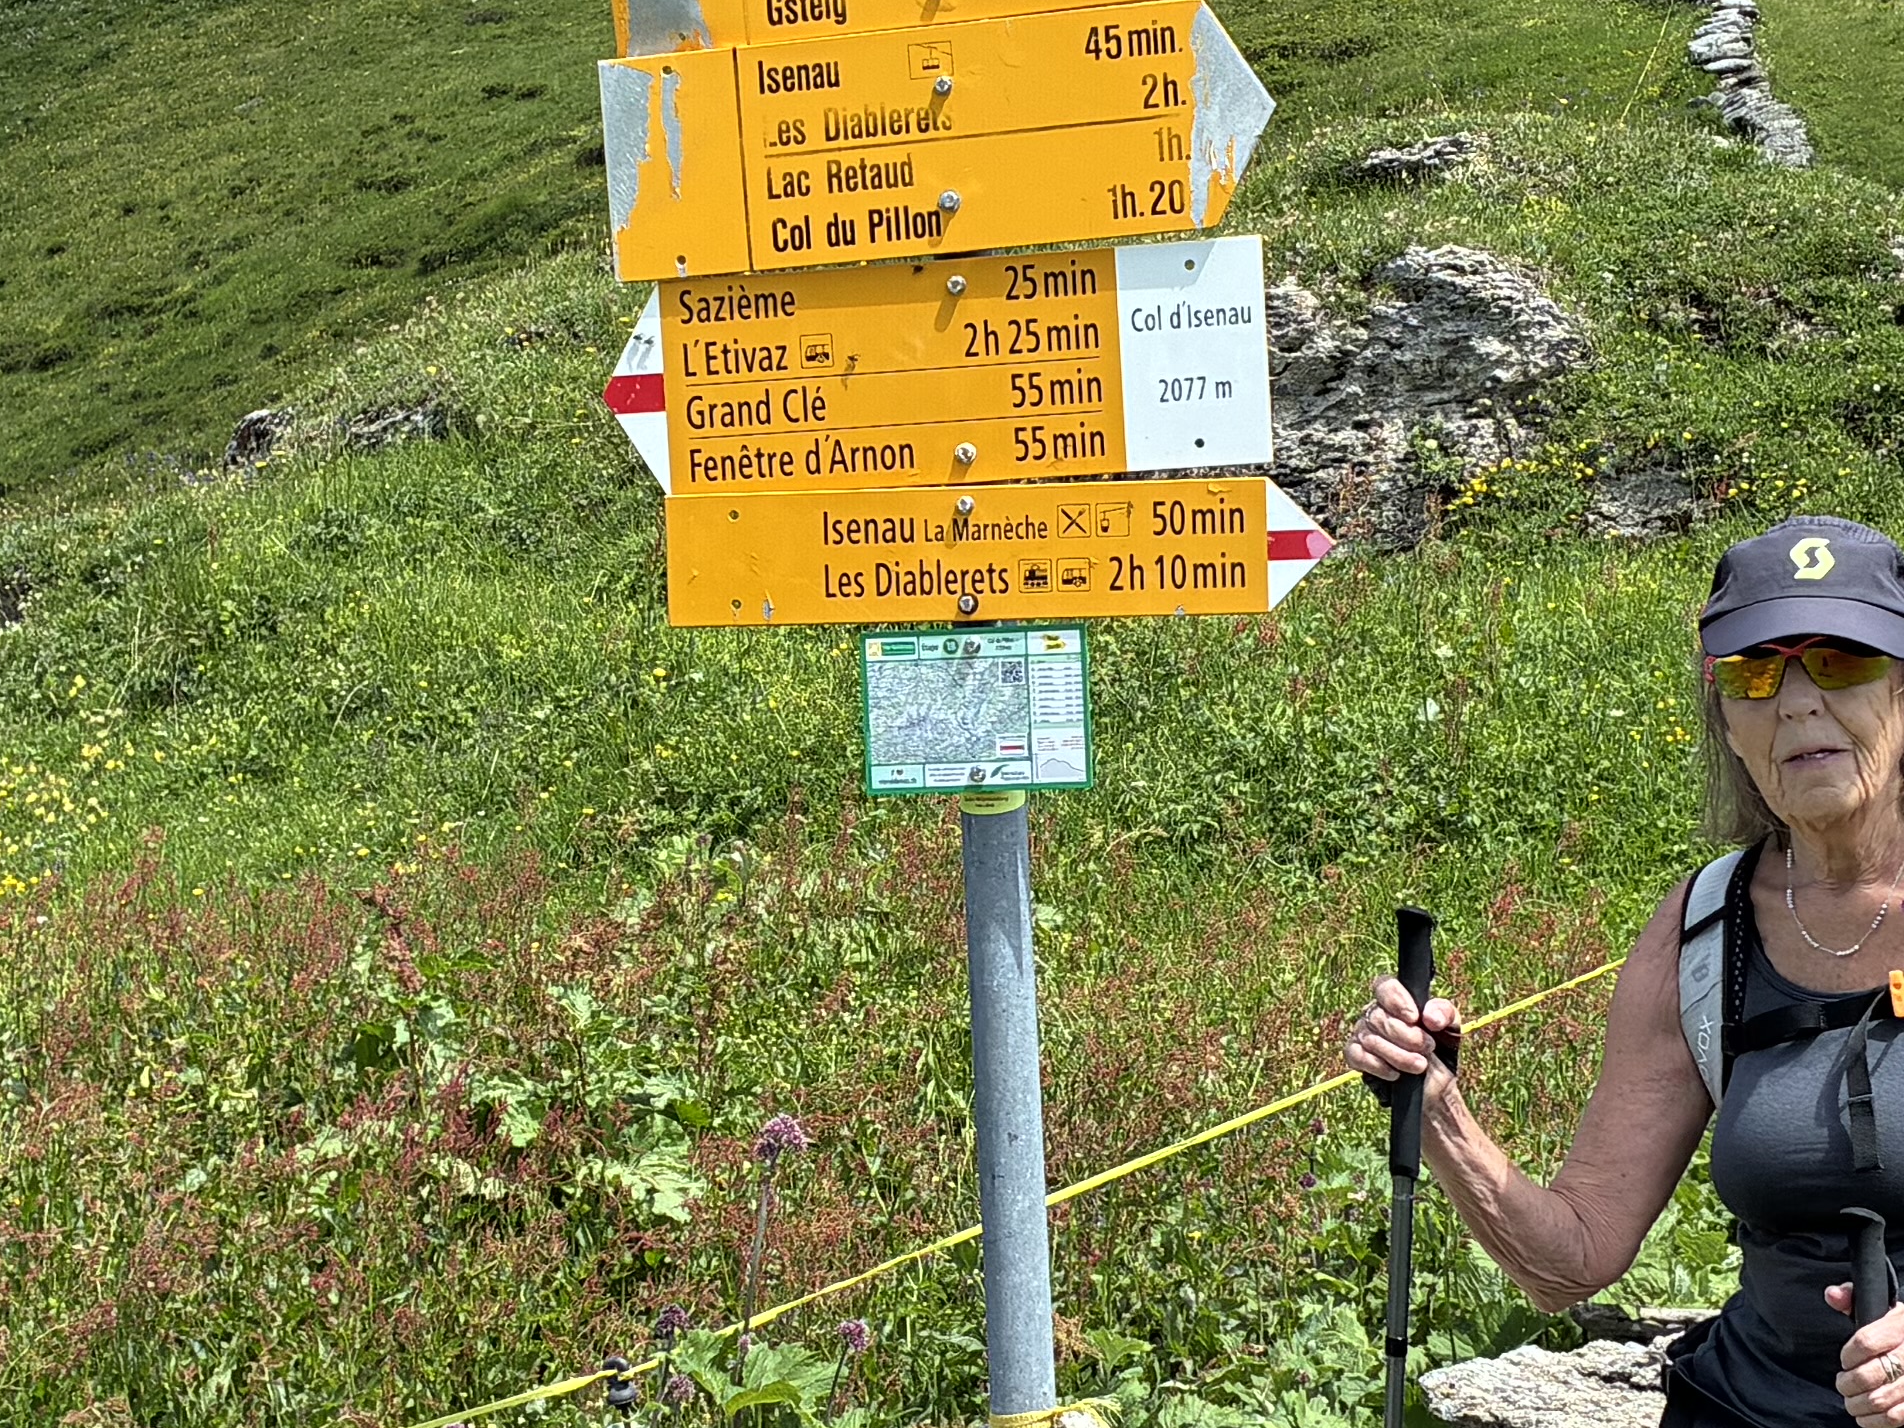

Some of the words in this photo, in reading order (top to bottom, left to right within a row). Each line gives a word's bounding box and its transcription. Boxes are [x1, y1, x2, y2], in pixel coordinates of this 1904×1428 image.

[757, 60, 841, 95] Isenau
[823, 102, 953, 142] Diablerets
[766, 166, 811, 200] Lac
[826, 152, 914, 194] Retaud
[771, 214, 812, 252] Col
[826, 212, 856, 247] du
[868, 205, 942, 243] Pillon
[679, 285, 796, 324] Sazième
[1131, 305, 1162, 332] Col
[1169, 300, 1252, 330] d'Isenau
[682, 338, 789, 378] L'Etivaz
[686, 388, 771, 430] Grand
[783, 385, 827, 424] Clé
[1158, 376, 1207, 403] 2077
[1215, 380, 1232, 399] m
[689, 444, 794, 483] Fenêtre
[805, 434, 915, 475] d'Arnon
[823, 511, 915, 546] Isenau
[924, 519, 945, 543] La
[952, 514, 1049, 542] Marnèche
[824, 564, 865, 598] Les
[875, 558, 1010, 597] Diablerets
